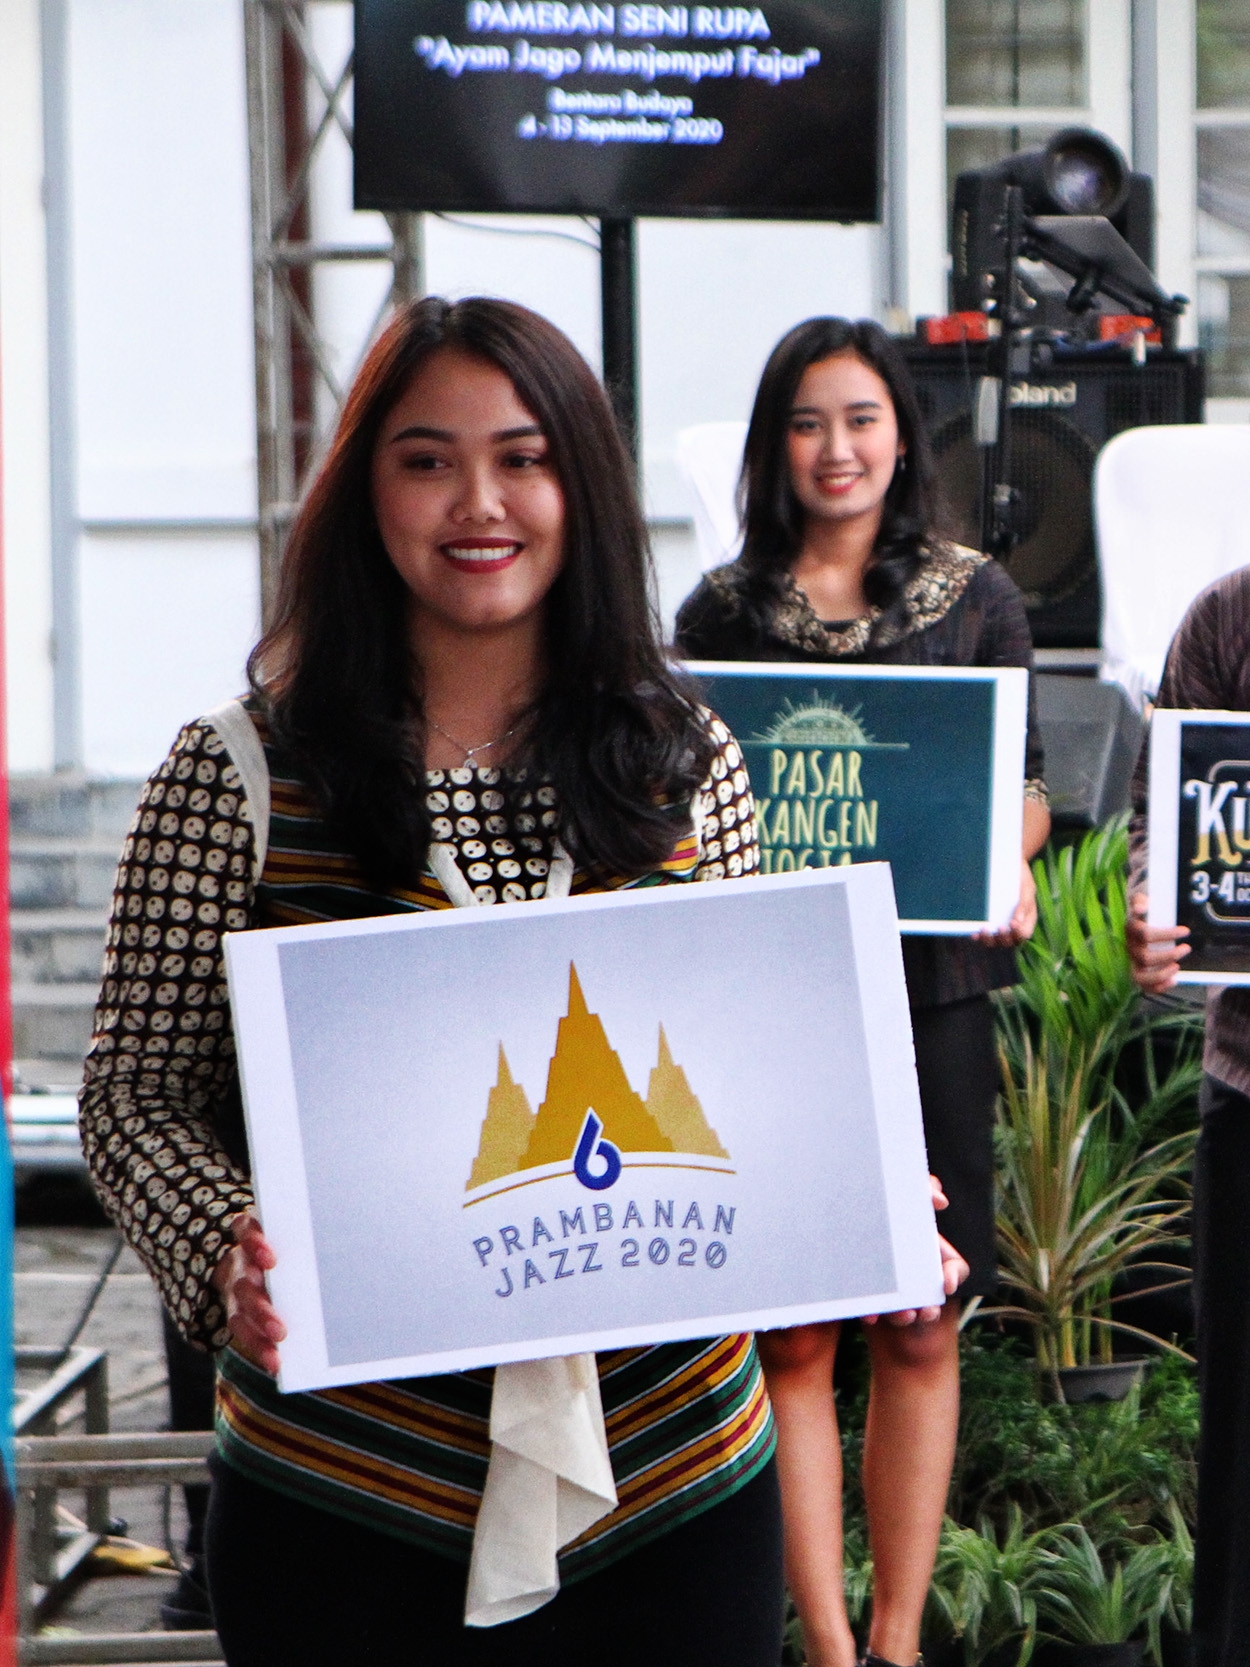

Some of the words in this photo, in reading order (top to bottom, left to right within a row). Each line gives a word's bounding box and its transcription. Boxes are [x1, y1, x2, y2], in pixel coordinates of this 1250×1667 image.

[466, 0, 615, 35] PAMERAN
[618, 3, 689, 38] SENI
[692, 5, 771, 40] RUPA
[513, 39, 582, 80] Jago
[584, 41, 735, 84] Menjemput
[547, 86, 622, 116] Bentara
[622, 89, 694, 120] Budaya
[517, 112, 537, 140] 4
[547, 114, 573, 141] 13
[573, 114, 671, 146] September
[671, 117, 724, 145] 2020
[1007, 381, 1078, 408] oland
[771, 749, 864, 798] PASAR
[755, 798, 878, 848] KANGEN
[1191, 870, 1235, 904] 3-4
[573, 1111, 623, 1192] 6
[472, 1199, 737, 1267] PRAMBANAN
[495, 1242, 604, 1298] JAZZ
[620, 1237, 728, 1269] 2020
